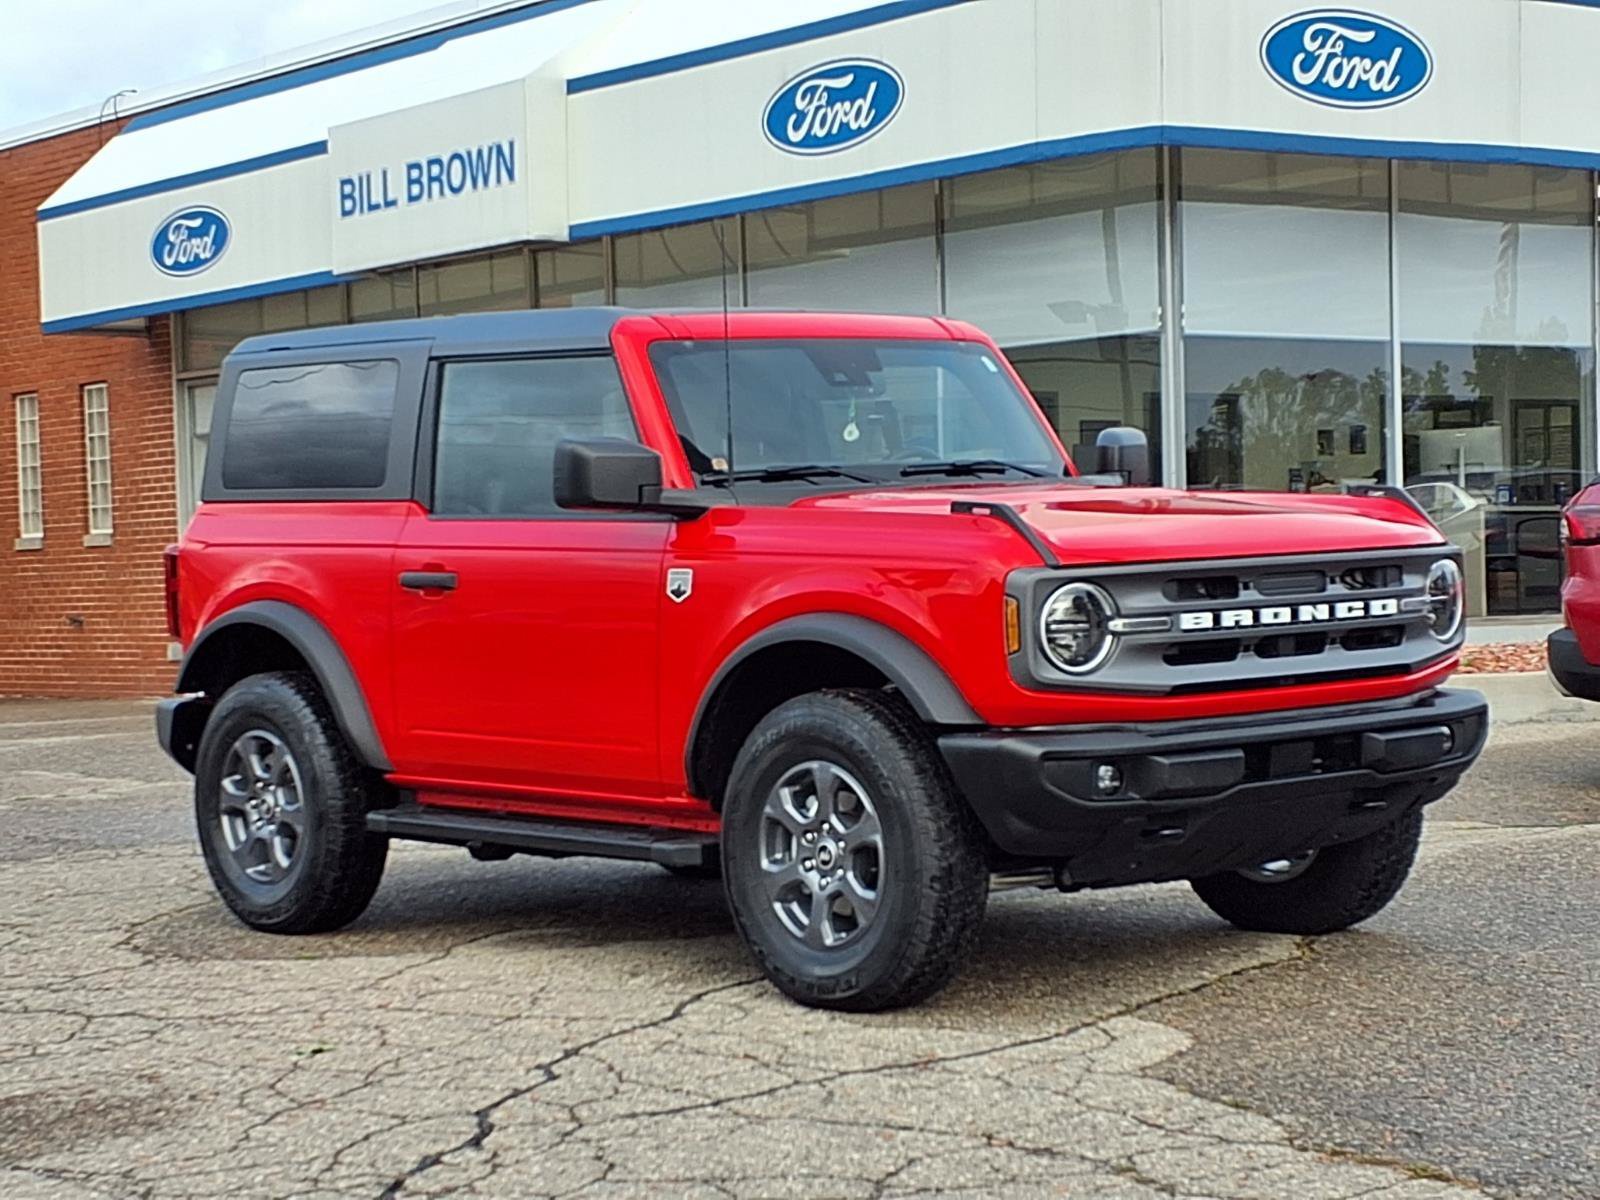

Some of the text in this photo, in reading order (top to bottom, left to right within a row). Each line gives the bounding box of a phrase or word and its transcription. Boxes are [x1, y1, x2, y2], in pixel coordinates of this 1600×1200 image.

[1292, 22, 1402, 92] Ford
[787, 73, 877, 142] Ford
[339, 139, 515, 218] BILL BROWN
[163, 217, 216, 266] Ford
[1180, 599, 1398, 630] BRONCO
